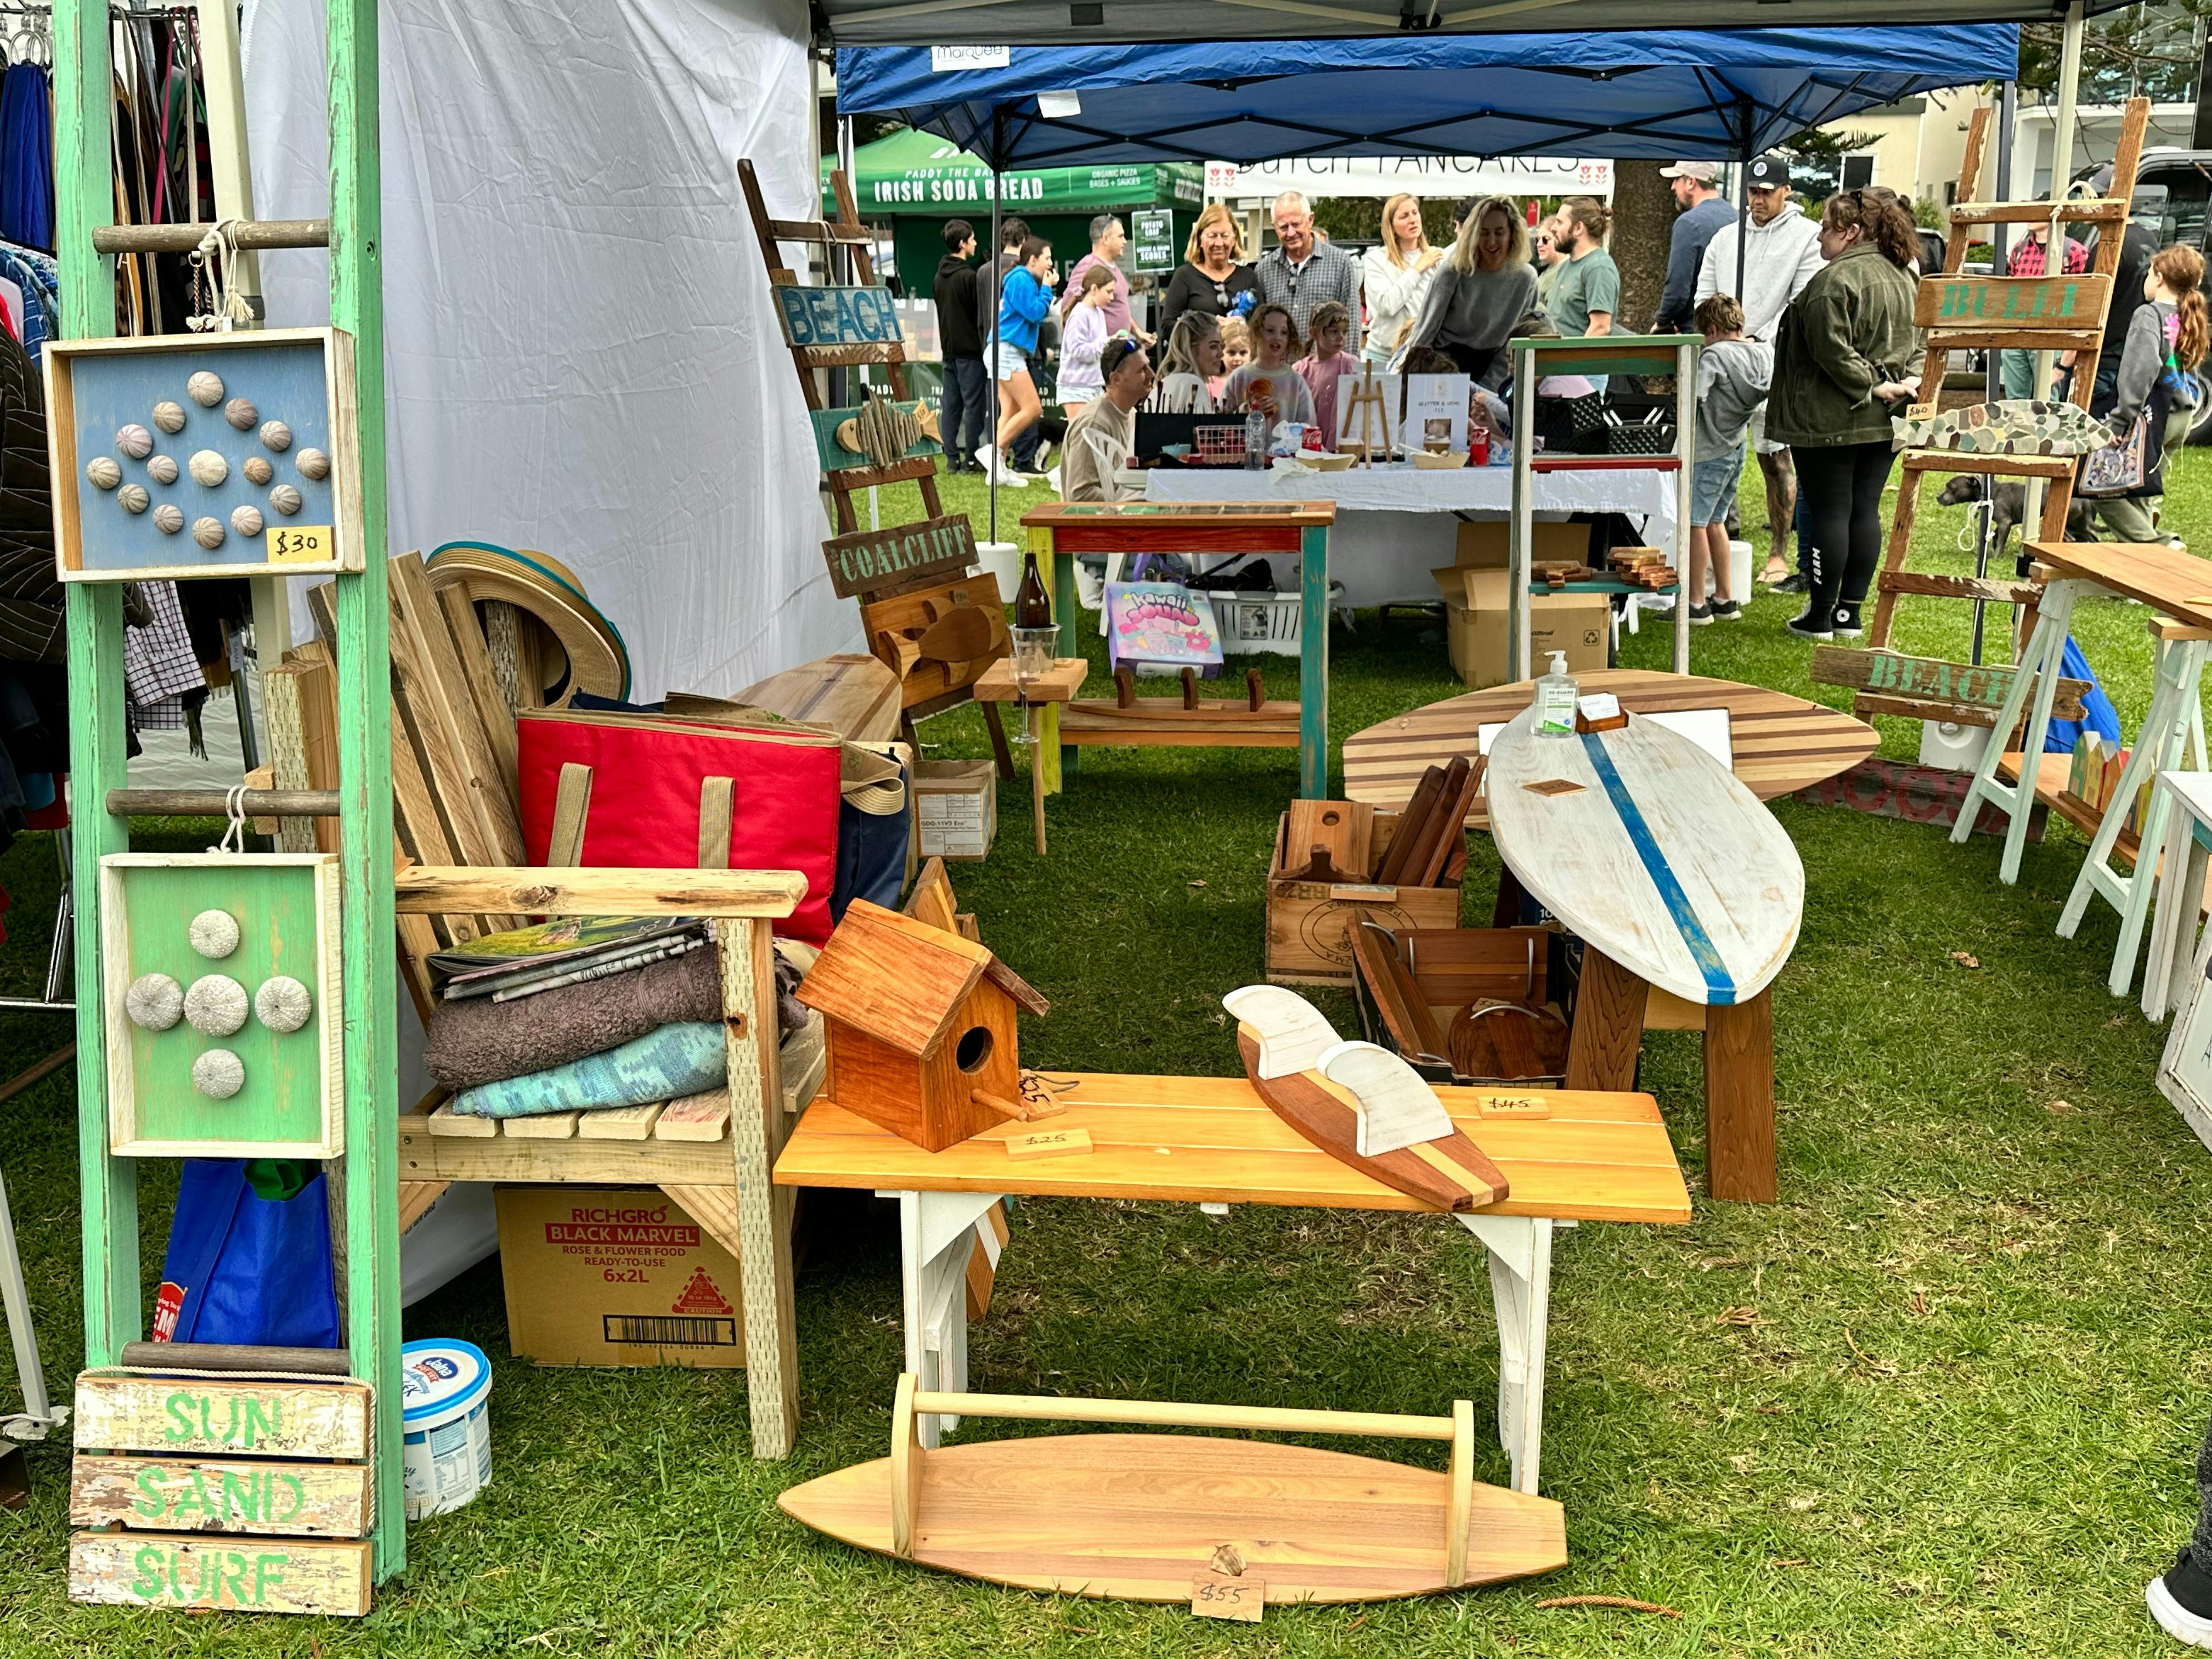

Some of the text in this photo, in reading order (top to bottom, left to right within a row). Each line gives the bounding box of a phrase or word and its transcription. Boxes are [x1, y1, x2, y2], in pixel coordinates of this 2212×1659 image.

[905, 168, 942, 178] PADDY
[949, 168, 969, 177] THE
[1119, 167, 1137, 176] PIZZA
[874, 178, 1043, 202] IRISH SODA BREAD
[1116, 177, 1141, 186] SAUCES
[1940, 284, 2079, 319] BULLI
[781, 290, 901, 343] BEACH
[1909, 407, 1928, 417] $40
[276, 531, 318, 556] $30
[839, 524, 967, 583] COALCLIFF
[1812, 547, 1822, 585] FORM
[1867, 655, 2017, 705] BEACH
[1488, 1098, 1531, 1109] $45
[1026, 1133, 1066, 1145] $25
[572, 1206, 668, 1224] RICHGRO
[551, 1226, 696, 1243] BLACK MARVEL
[562, 1245, 686, 1257] ROSE & FLOWER FOOD
[584, 1256, 666, 1267] READY-TO-USE
[603, 1268, 650, 1283] 6x2L
[425, 1359, 453, 1377] Jalna
[165, 1392, 280, 1444] SUN
[136, 1466, 304, 1525] SAND
[132, 1545, 289, 1605] SURF
[1200, 1582, 1250, 1604] $55
